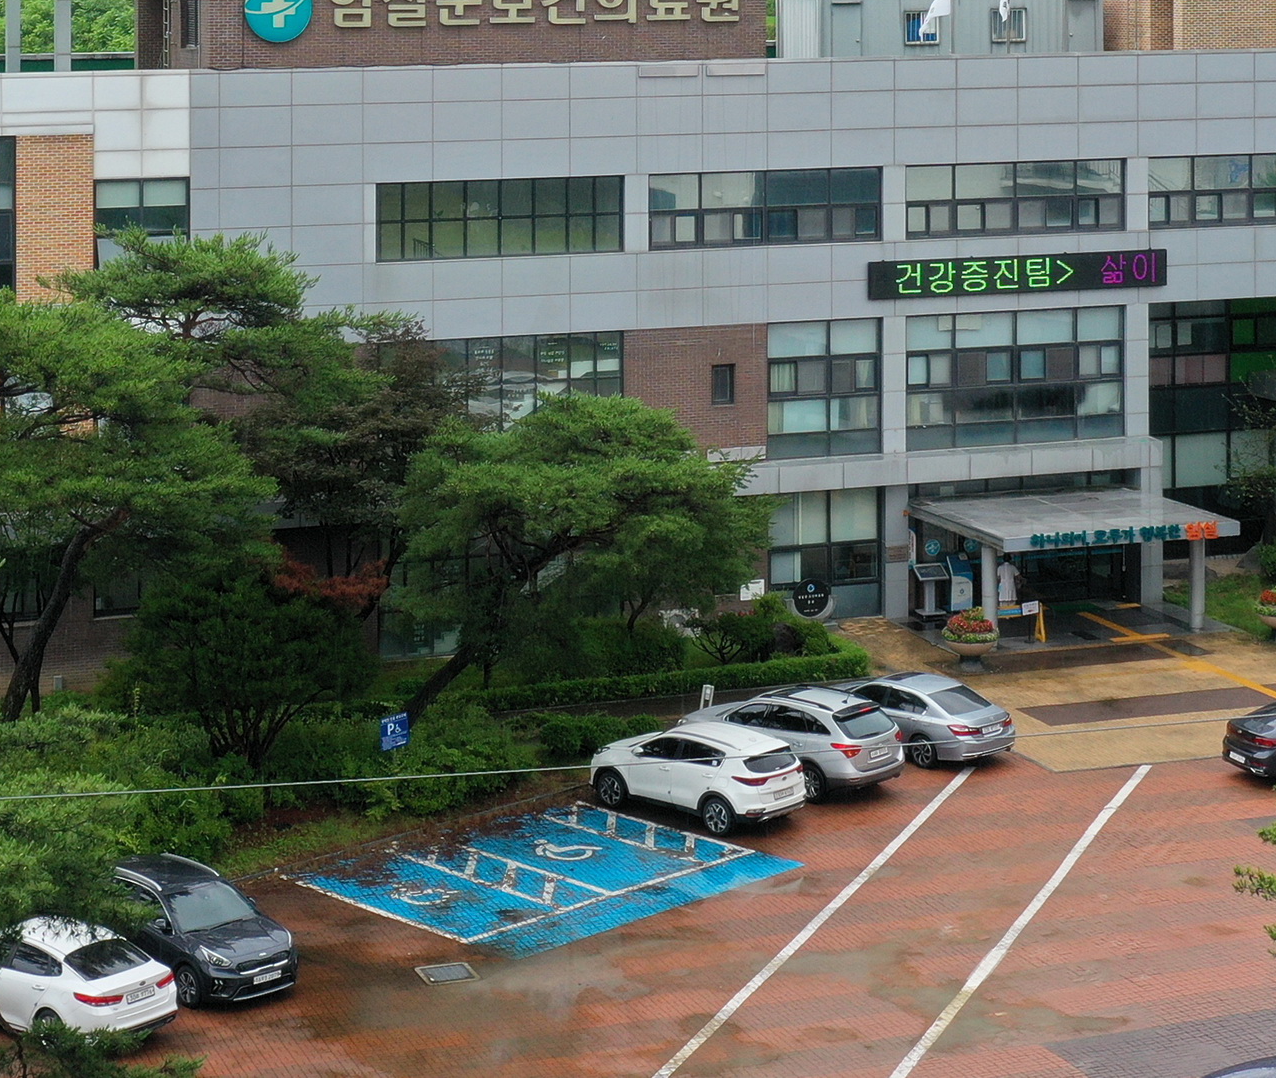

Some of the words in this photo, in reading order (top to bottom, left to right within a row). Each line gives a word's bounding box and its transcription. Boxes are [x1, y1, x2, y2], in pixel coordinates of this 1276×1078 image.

[1100, 252, 1156, 283] 삶이
[1092, 526, 1136, 544] 모두가
[1139, 524, 1181, 542] 행복한
[1185, 521, 1220, 541] 임실
